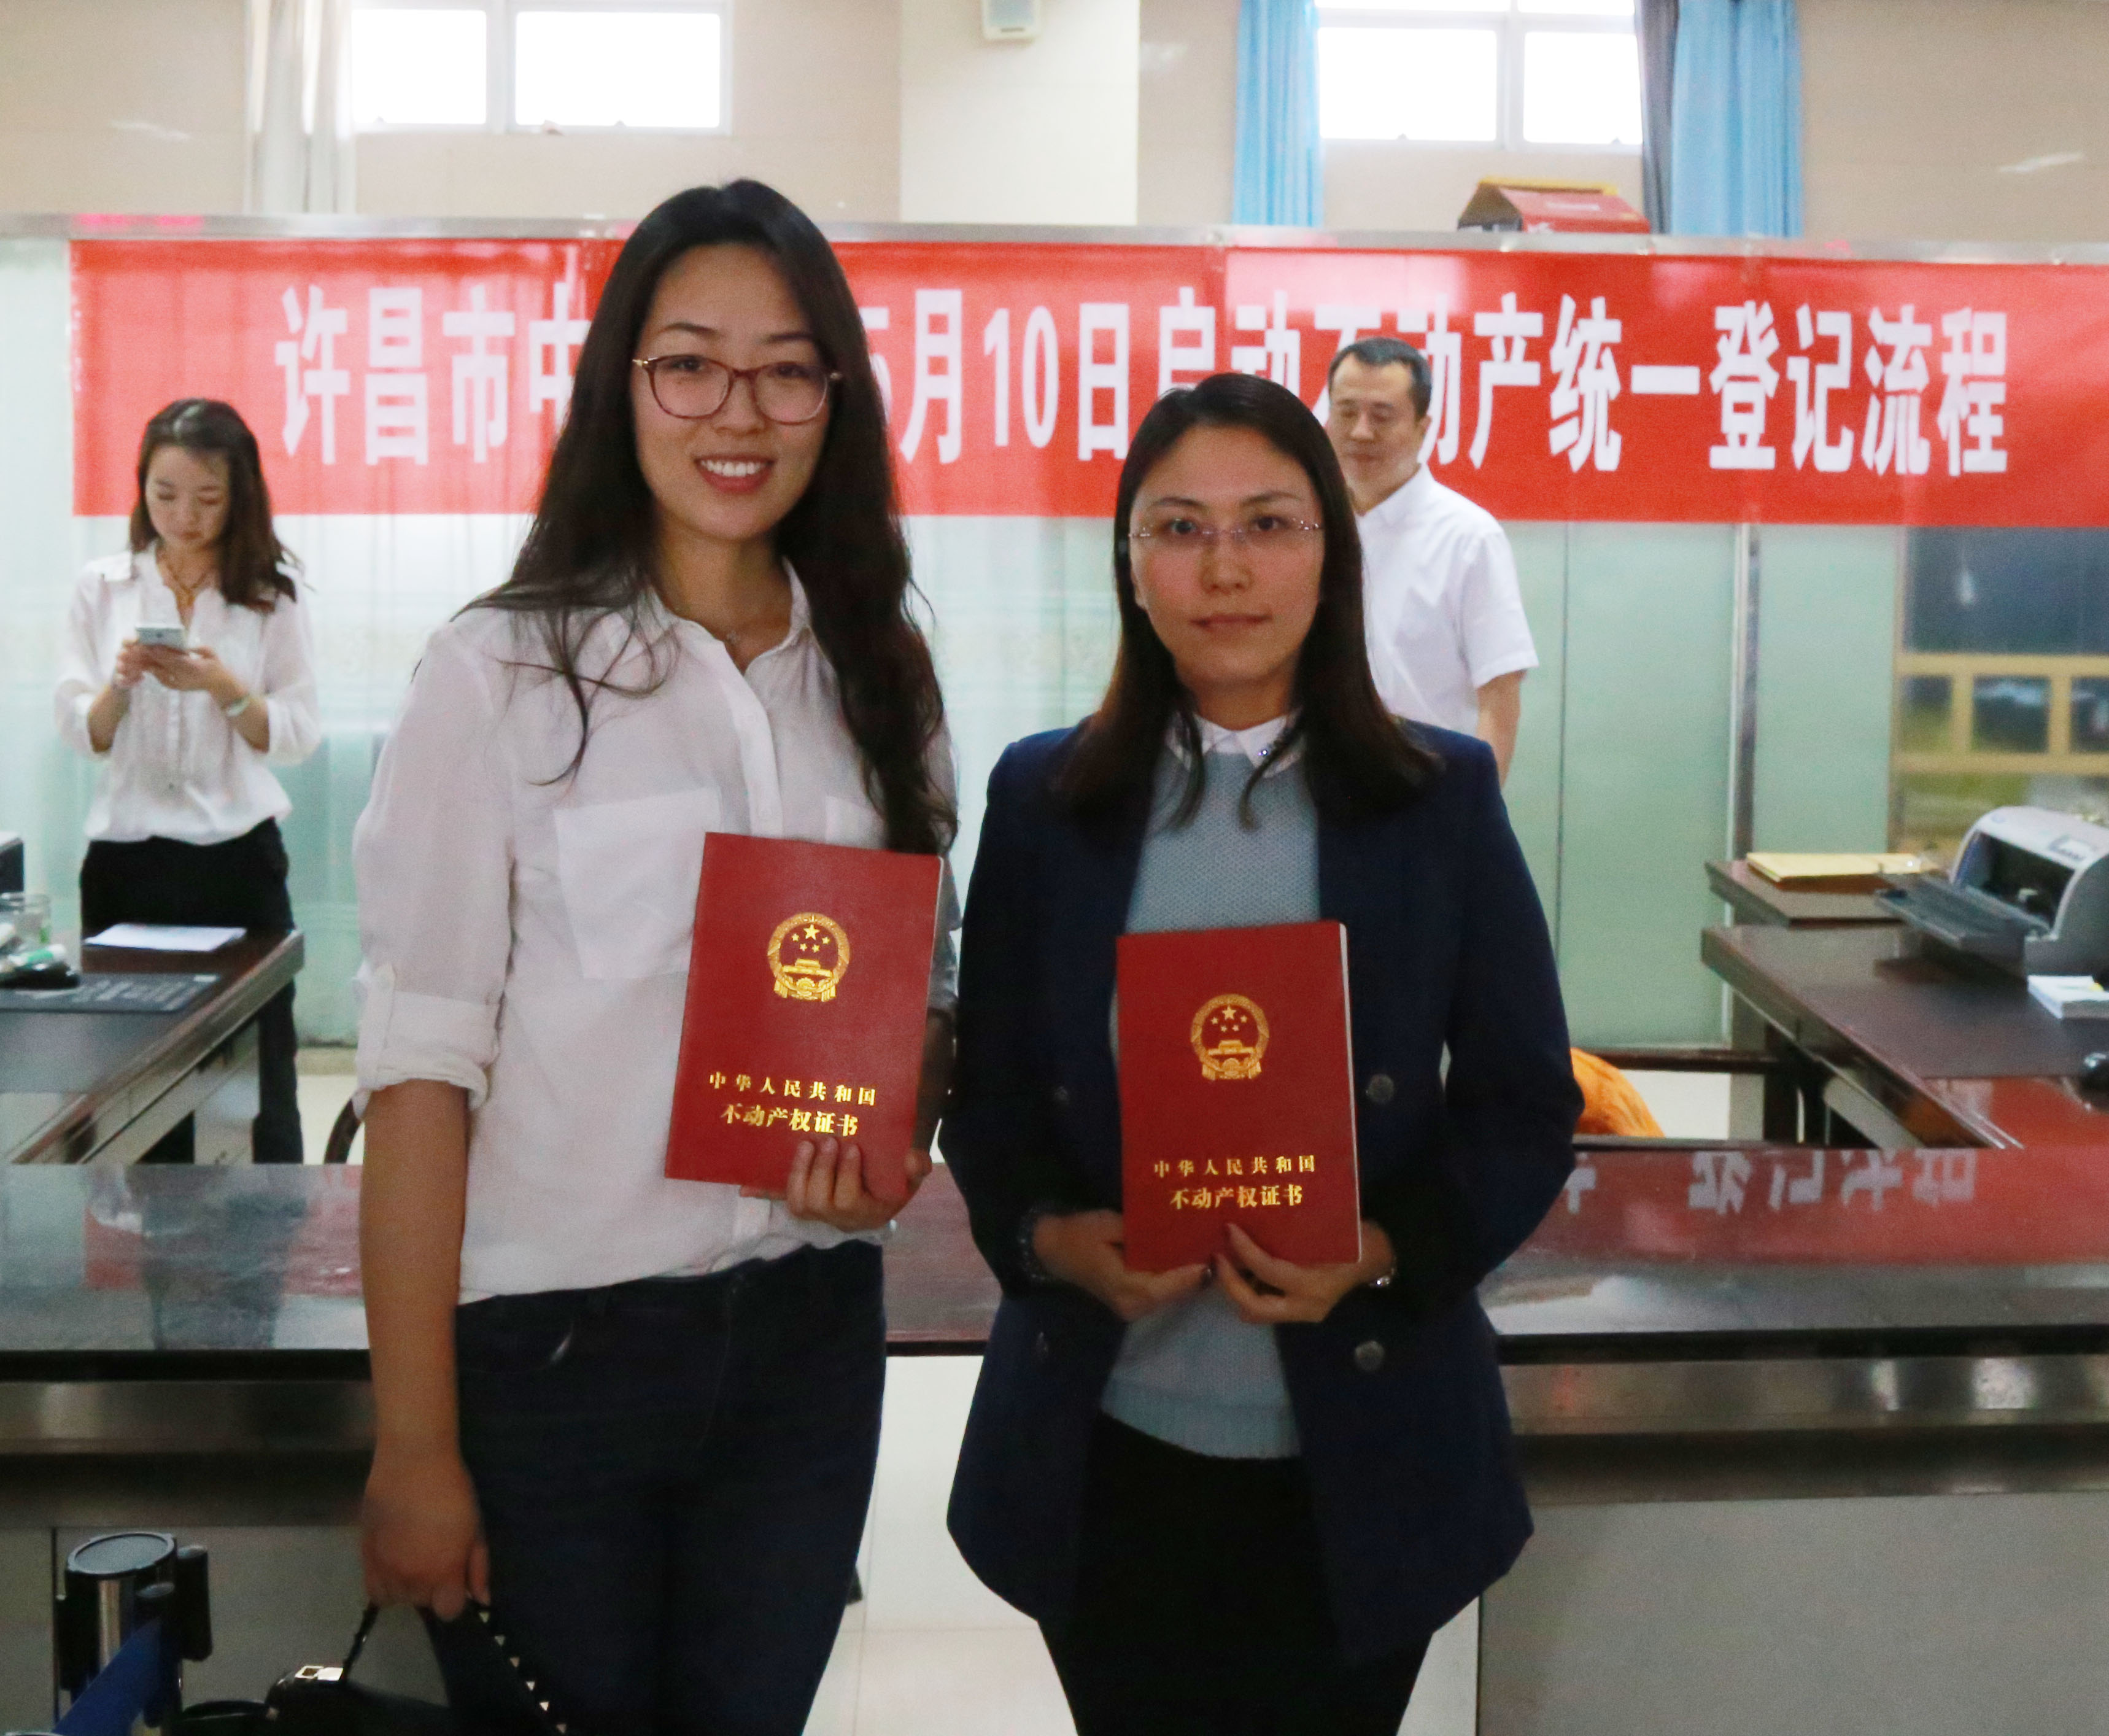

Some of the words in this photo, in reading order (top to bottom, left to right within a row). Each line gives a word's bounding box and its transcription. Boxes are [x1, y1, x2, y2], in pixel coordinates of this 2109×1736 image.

[710, 1071, 876, 1106] 中华人民共和国
[721, 1104, 858, 1136] 不动产权证书
[1154, 1155, 1315, 1177] 中华人民共和国
[1170, 1184, 1302, 1209] 不动产权证书
